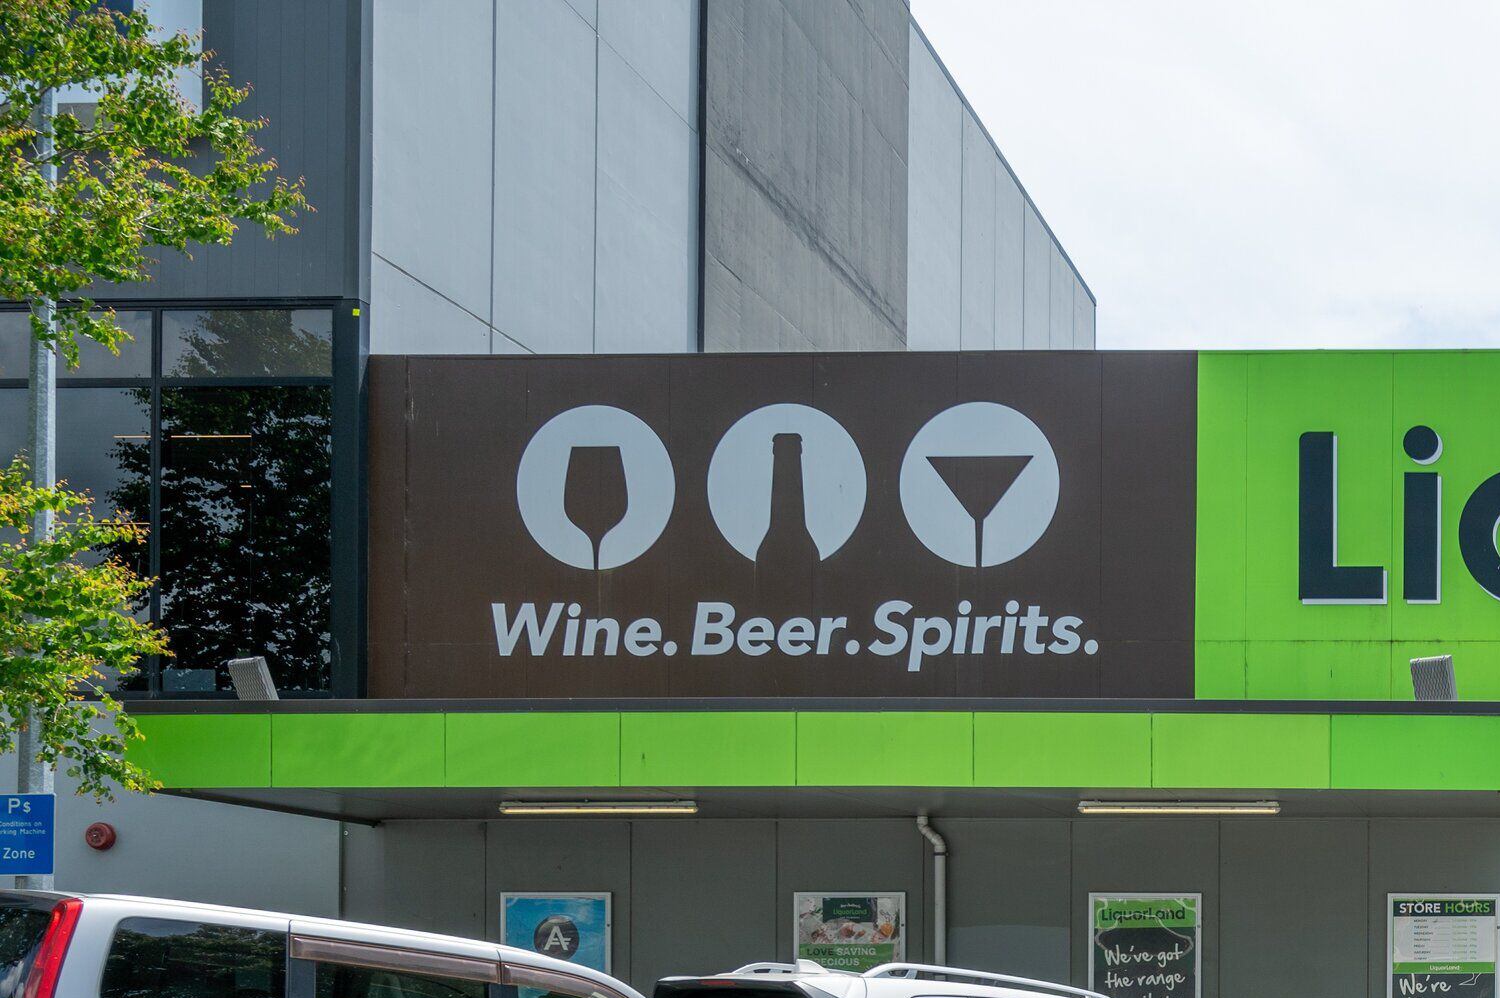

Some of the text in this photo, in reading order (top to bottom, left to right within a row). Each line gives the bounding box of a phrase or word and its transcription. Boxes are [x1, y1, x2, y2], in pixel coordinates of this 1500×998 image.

[492, 600, 1100, 672] Wine. Beer. Spirits.
[3, 847, 36, 859] Zone
[1101, 907, 1186, 923] LiquorLand
[1399, 902, 1491, 914] STORE HOURS
[807, 947, 877, 956] LOVE SAVING
[1104, 943, 1183, 968] We've got
[1104, 971, 1186, 991] the range
[1400, 973, 1451, 996] We're
